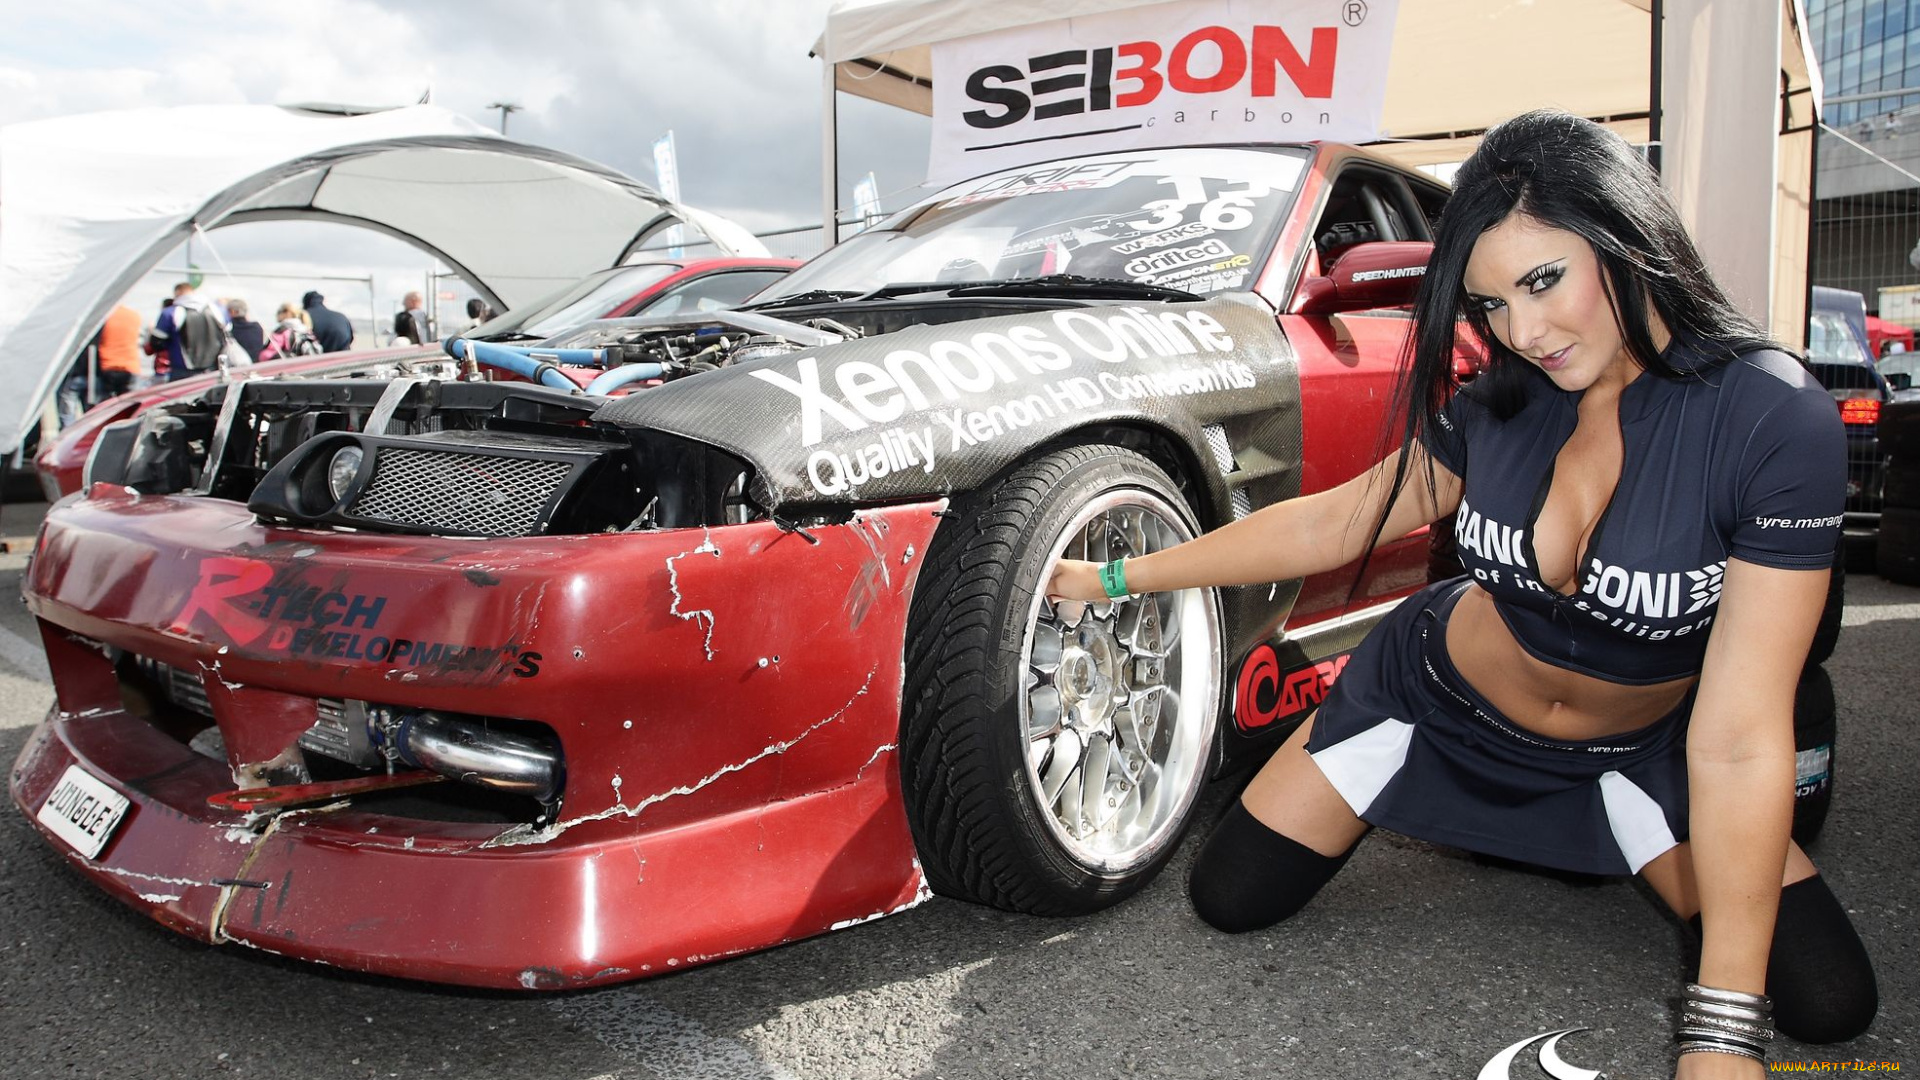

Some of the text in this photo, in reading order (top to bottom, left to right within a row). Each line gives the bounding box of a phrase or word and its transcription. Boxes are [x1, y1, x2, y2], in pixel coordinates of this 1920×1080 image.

[963, 25, 1338, 129] SEIBON
[1147, 108, 1330, 128] carbon
[1130, 240, 1226, 274] drifted
[749, 307, 1234, 447] Xenons Online
[807, 360, 1257, 496] Quality Xenon HID Conversion Kits
[1474, 568, 1500, 584] of
